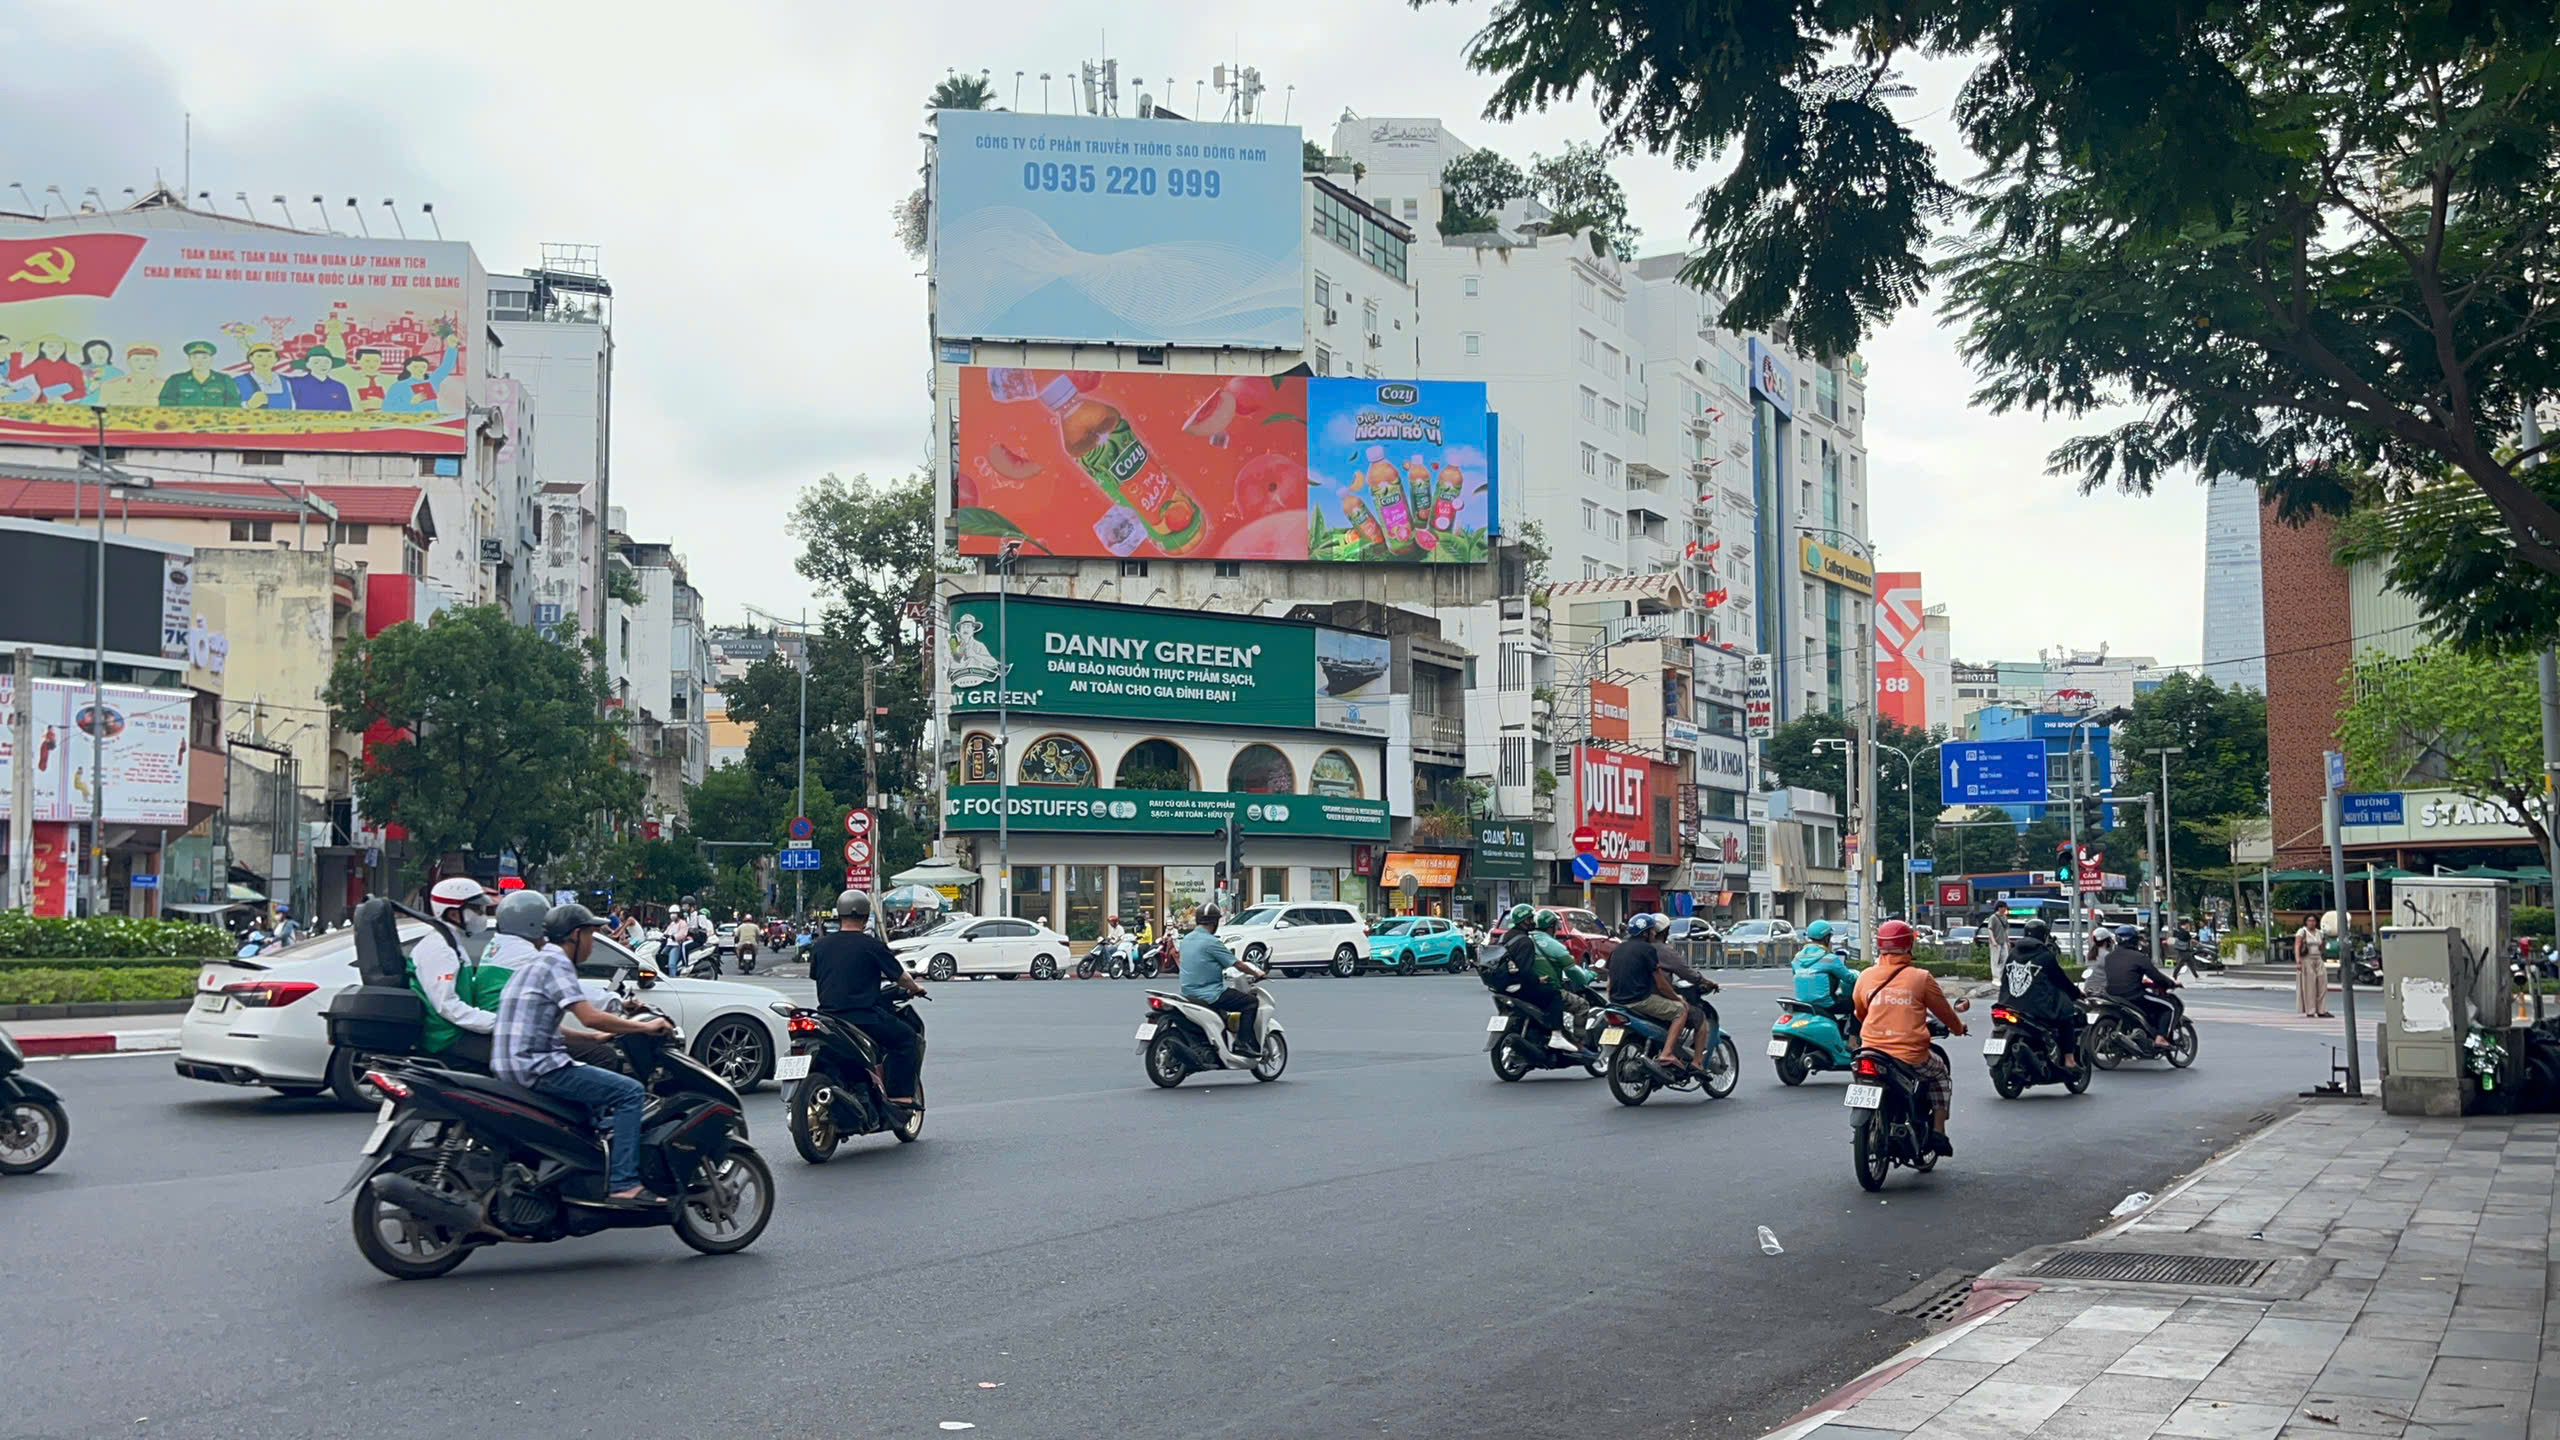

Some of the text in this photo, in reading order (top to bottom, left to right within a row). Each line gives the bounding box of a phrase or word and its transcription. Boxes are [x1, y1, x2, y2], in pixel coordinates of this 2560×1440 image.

[975, 133, 1267, 162] CÔNG TY CỔ PHẦN TRUYỀN THÔNG SAO ĐÔNG NAM
[1023, 161, 1221, 199] 0935 220 999
[1381, 387, 1414, 403] Cozy
[1356, 425, 1398, 439] NGON
[1115, 444, 1146, 476] Cozy
[164, 628, 189, 646] 7K
[1045, 631, 1253, 669] DANNY GREEN
[1078, 661, 1105, 676] BẢO
[1107, 662, 1150, 679] NGUỒN
[1152, 667, 1185, 683] THỰC
[1187, 667, 1220, 685] PHẨM
[1222, 672, 1256, 688] SẠCH,
[1748, 676, 1767, 686] NHA
[1069, 680, 1088, 692] AN
[1090, 679, 1123, 695] TOÀN
[1126, 683, 1151, 697] CHO
[1154, 685, 1174, 698] GIA
[1175, 685, 1205, 701] ĐÌNH
[1206, 688, 1230, 703] BẠN
[1745, 689, 1771, 699] KHOA
[1746, 700, 1771, 713] TÂM
[1748, 714, 1770, 727] ĐỨC
[1700, 746, 1744, 777] NHA KHOA
[963, 798, 1089, 817] FOODSTUFFS
[2354, 797, 2390, 808] ĐƯỜNG
[2343, 808, 2370, 823] NGUYỄN
[1482, 829, 1525, 846] CRANE TEA
[1600, 829, 1629, 860] 50%
[2082, 871, 2098, 879] CẤM
[1884, 992, 1912, 1006] Food
